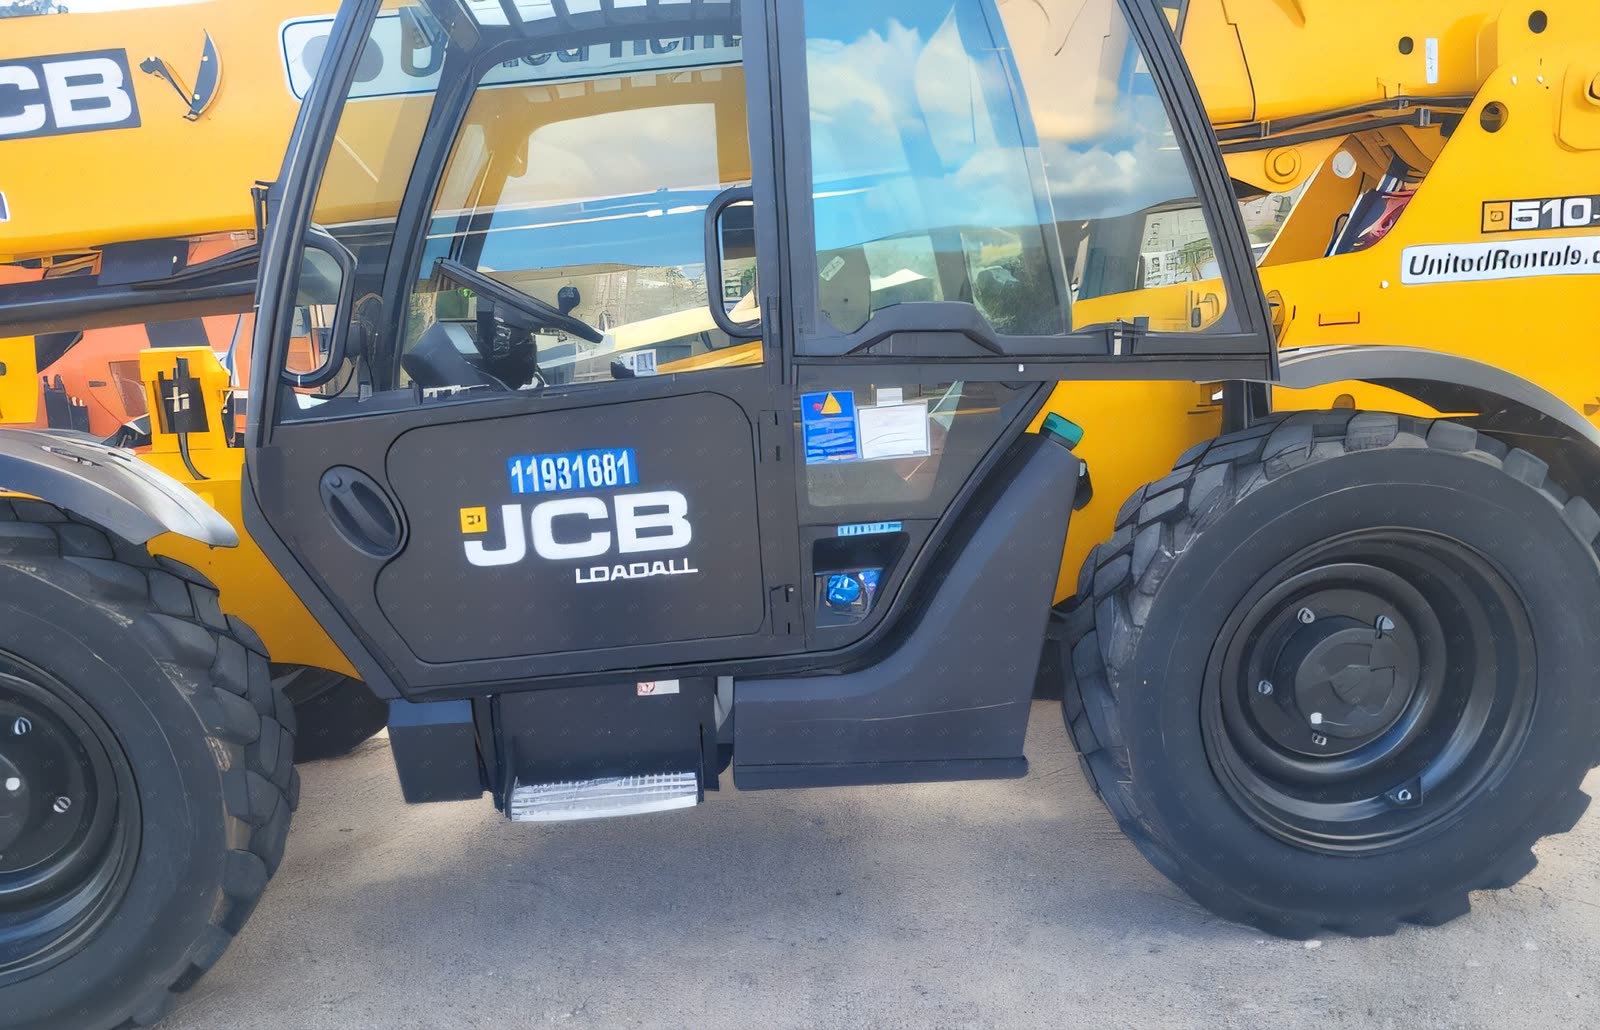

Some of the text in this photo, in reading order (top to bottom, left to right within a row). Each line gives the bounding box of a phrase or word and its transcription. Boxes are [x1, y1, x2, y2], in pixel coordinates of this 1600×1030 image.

[511, 450, 631, 493] 11931681
[463, 490, 692, 567] JCB
[575, 557, 698, 584] LOADALL
